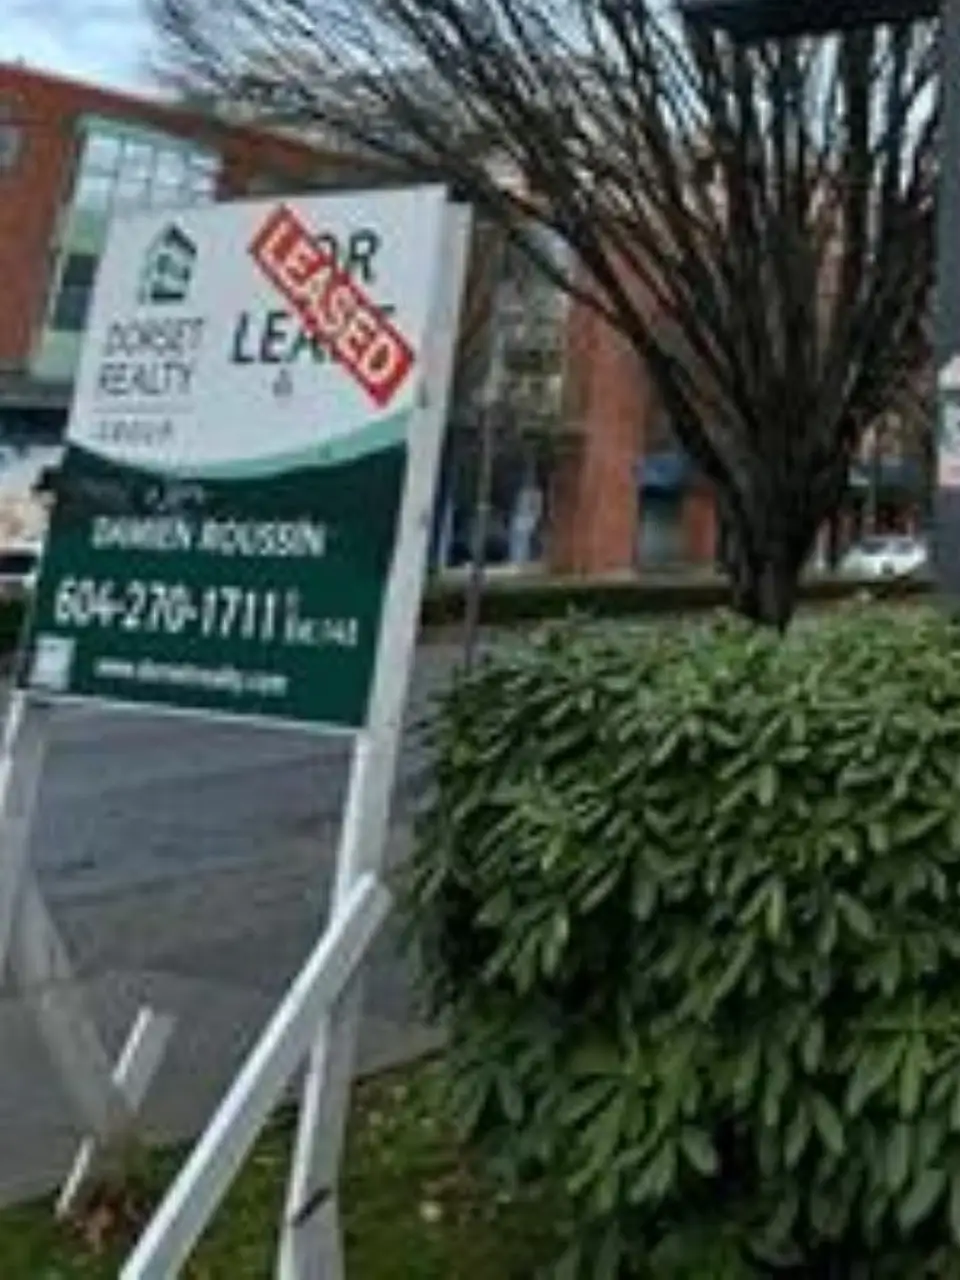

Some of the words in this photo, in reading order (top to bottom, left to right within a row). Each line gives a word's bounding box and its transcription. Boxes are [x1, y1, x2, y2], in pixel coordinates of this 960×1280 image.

[260, 220, 393, 383] LEASED
[98, 361, 193, 398] REALTY
[55, 578, 277, 643] 604-270-1711
